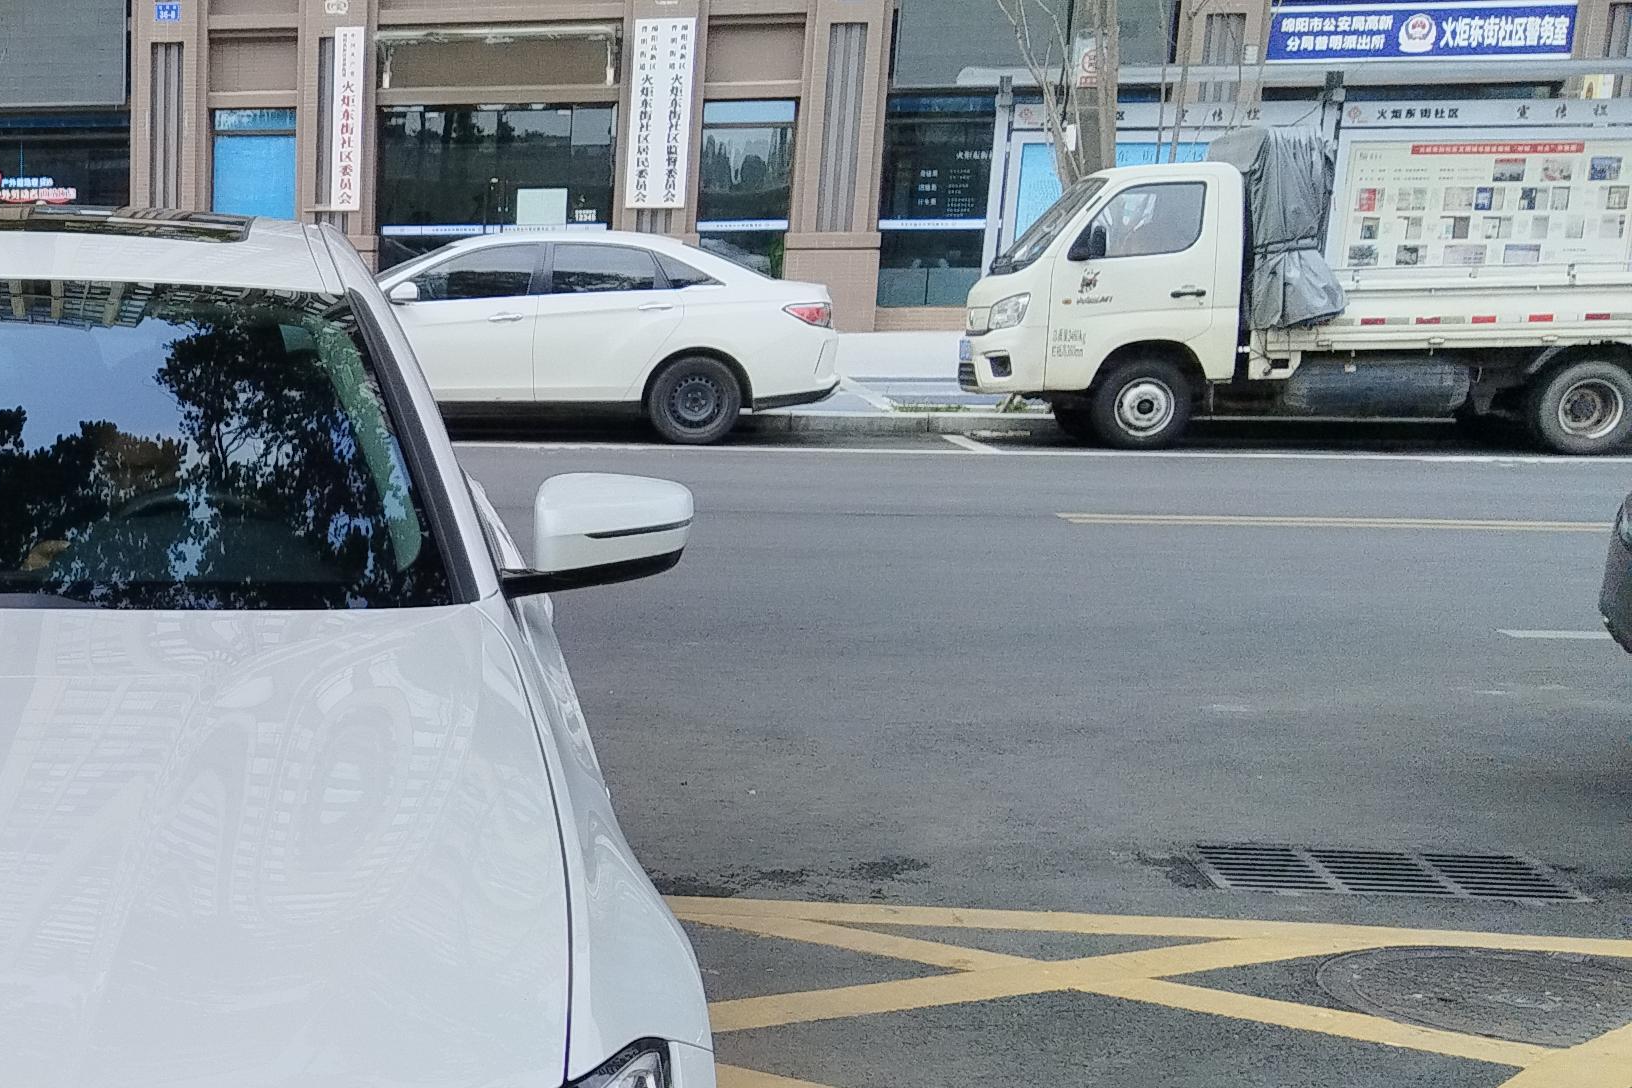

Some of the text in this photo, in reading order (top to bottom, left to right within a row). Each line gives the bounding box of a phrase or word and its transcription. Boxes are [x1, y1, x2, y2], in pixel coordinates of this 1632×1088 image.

[1280, 14, 1394, 34] 绵阳市公安局高新
[1439, 15, 1570, 49] 火炬东街社区警务室
[1285, 33, 1386, 52] 分局普明派出所
[1376, 107, 1460, 121] 火炬东街社区
